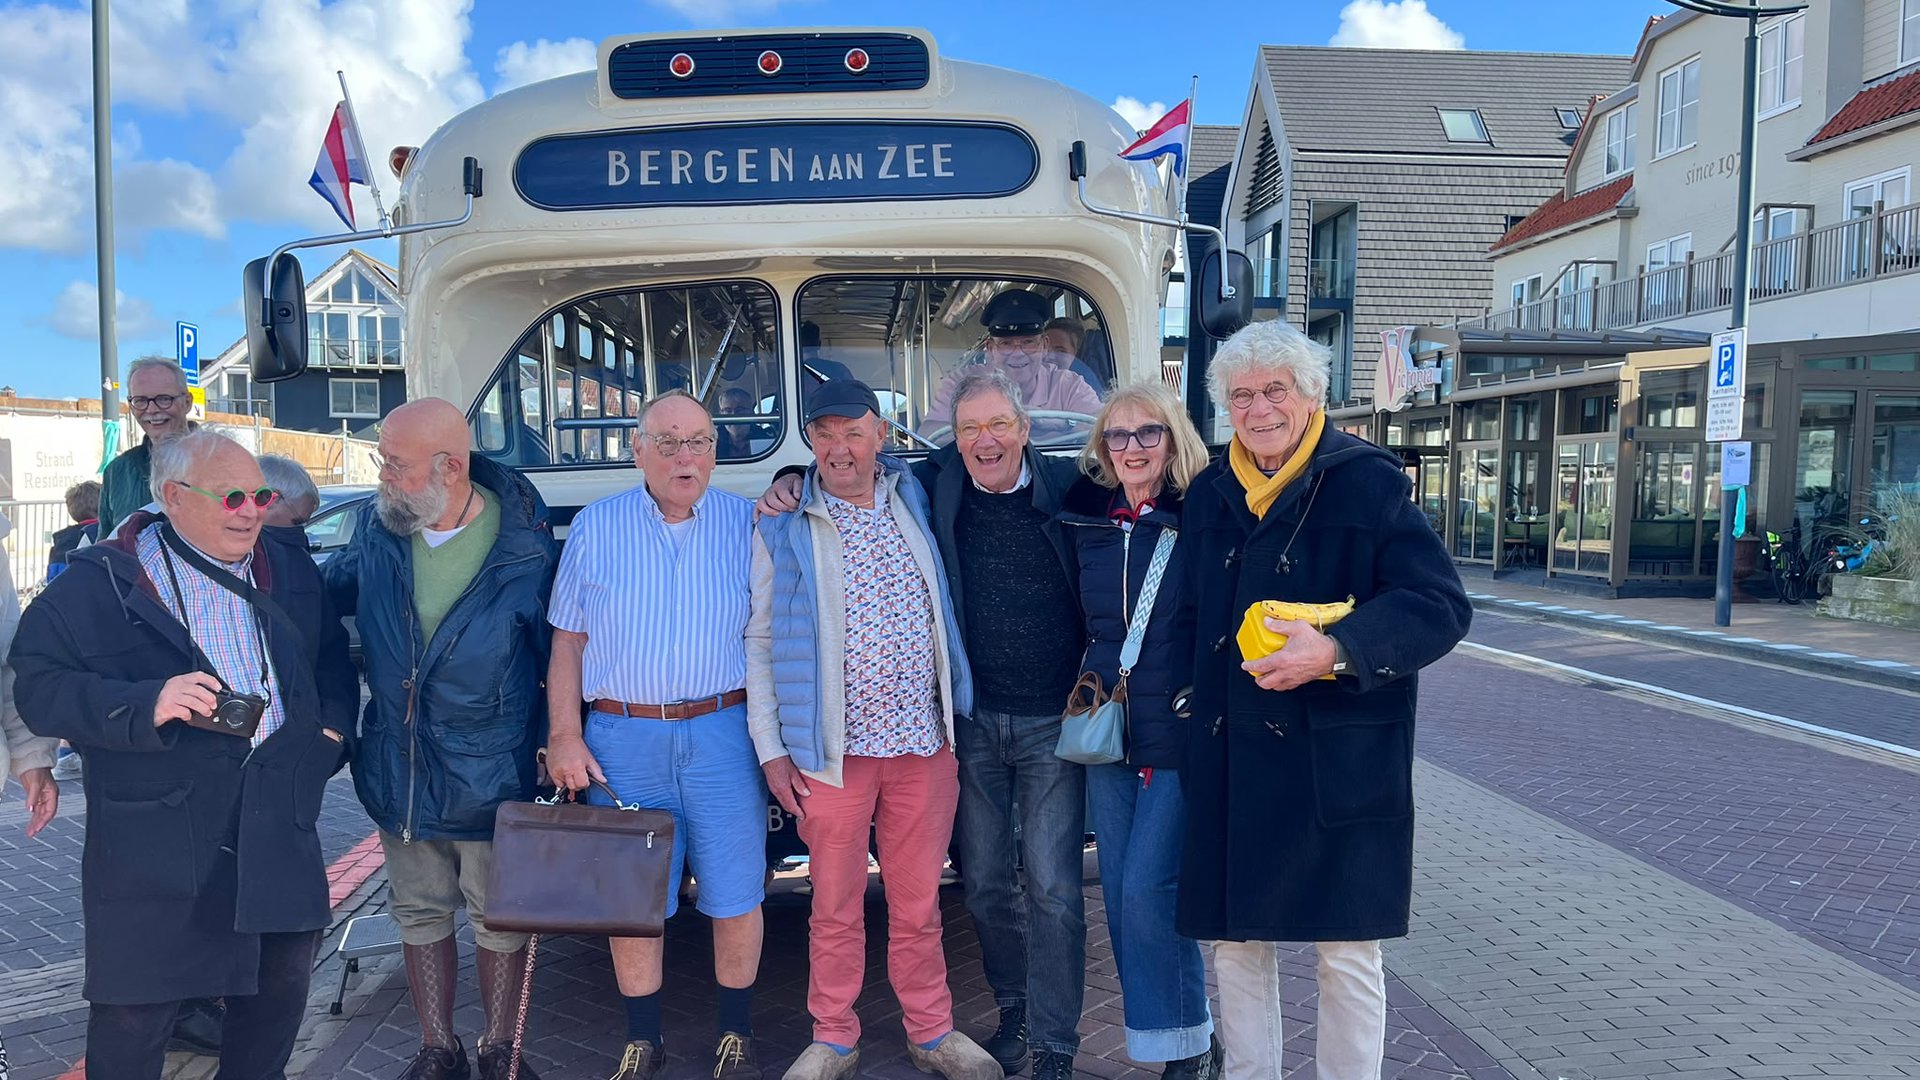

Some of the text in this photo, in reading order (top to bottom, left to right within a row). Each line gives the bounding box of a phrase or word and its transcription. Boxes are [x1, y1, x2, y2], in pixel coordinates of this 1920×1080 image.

[607, 143, 955, 186] BERGEN AAN ZEE
[1685, 162, 1715, 186] since
[183, 327, 195, 358] P
[1720, 346, 1732, 371] P
[35, 450, 75, 468] Strand
